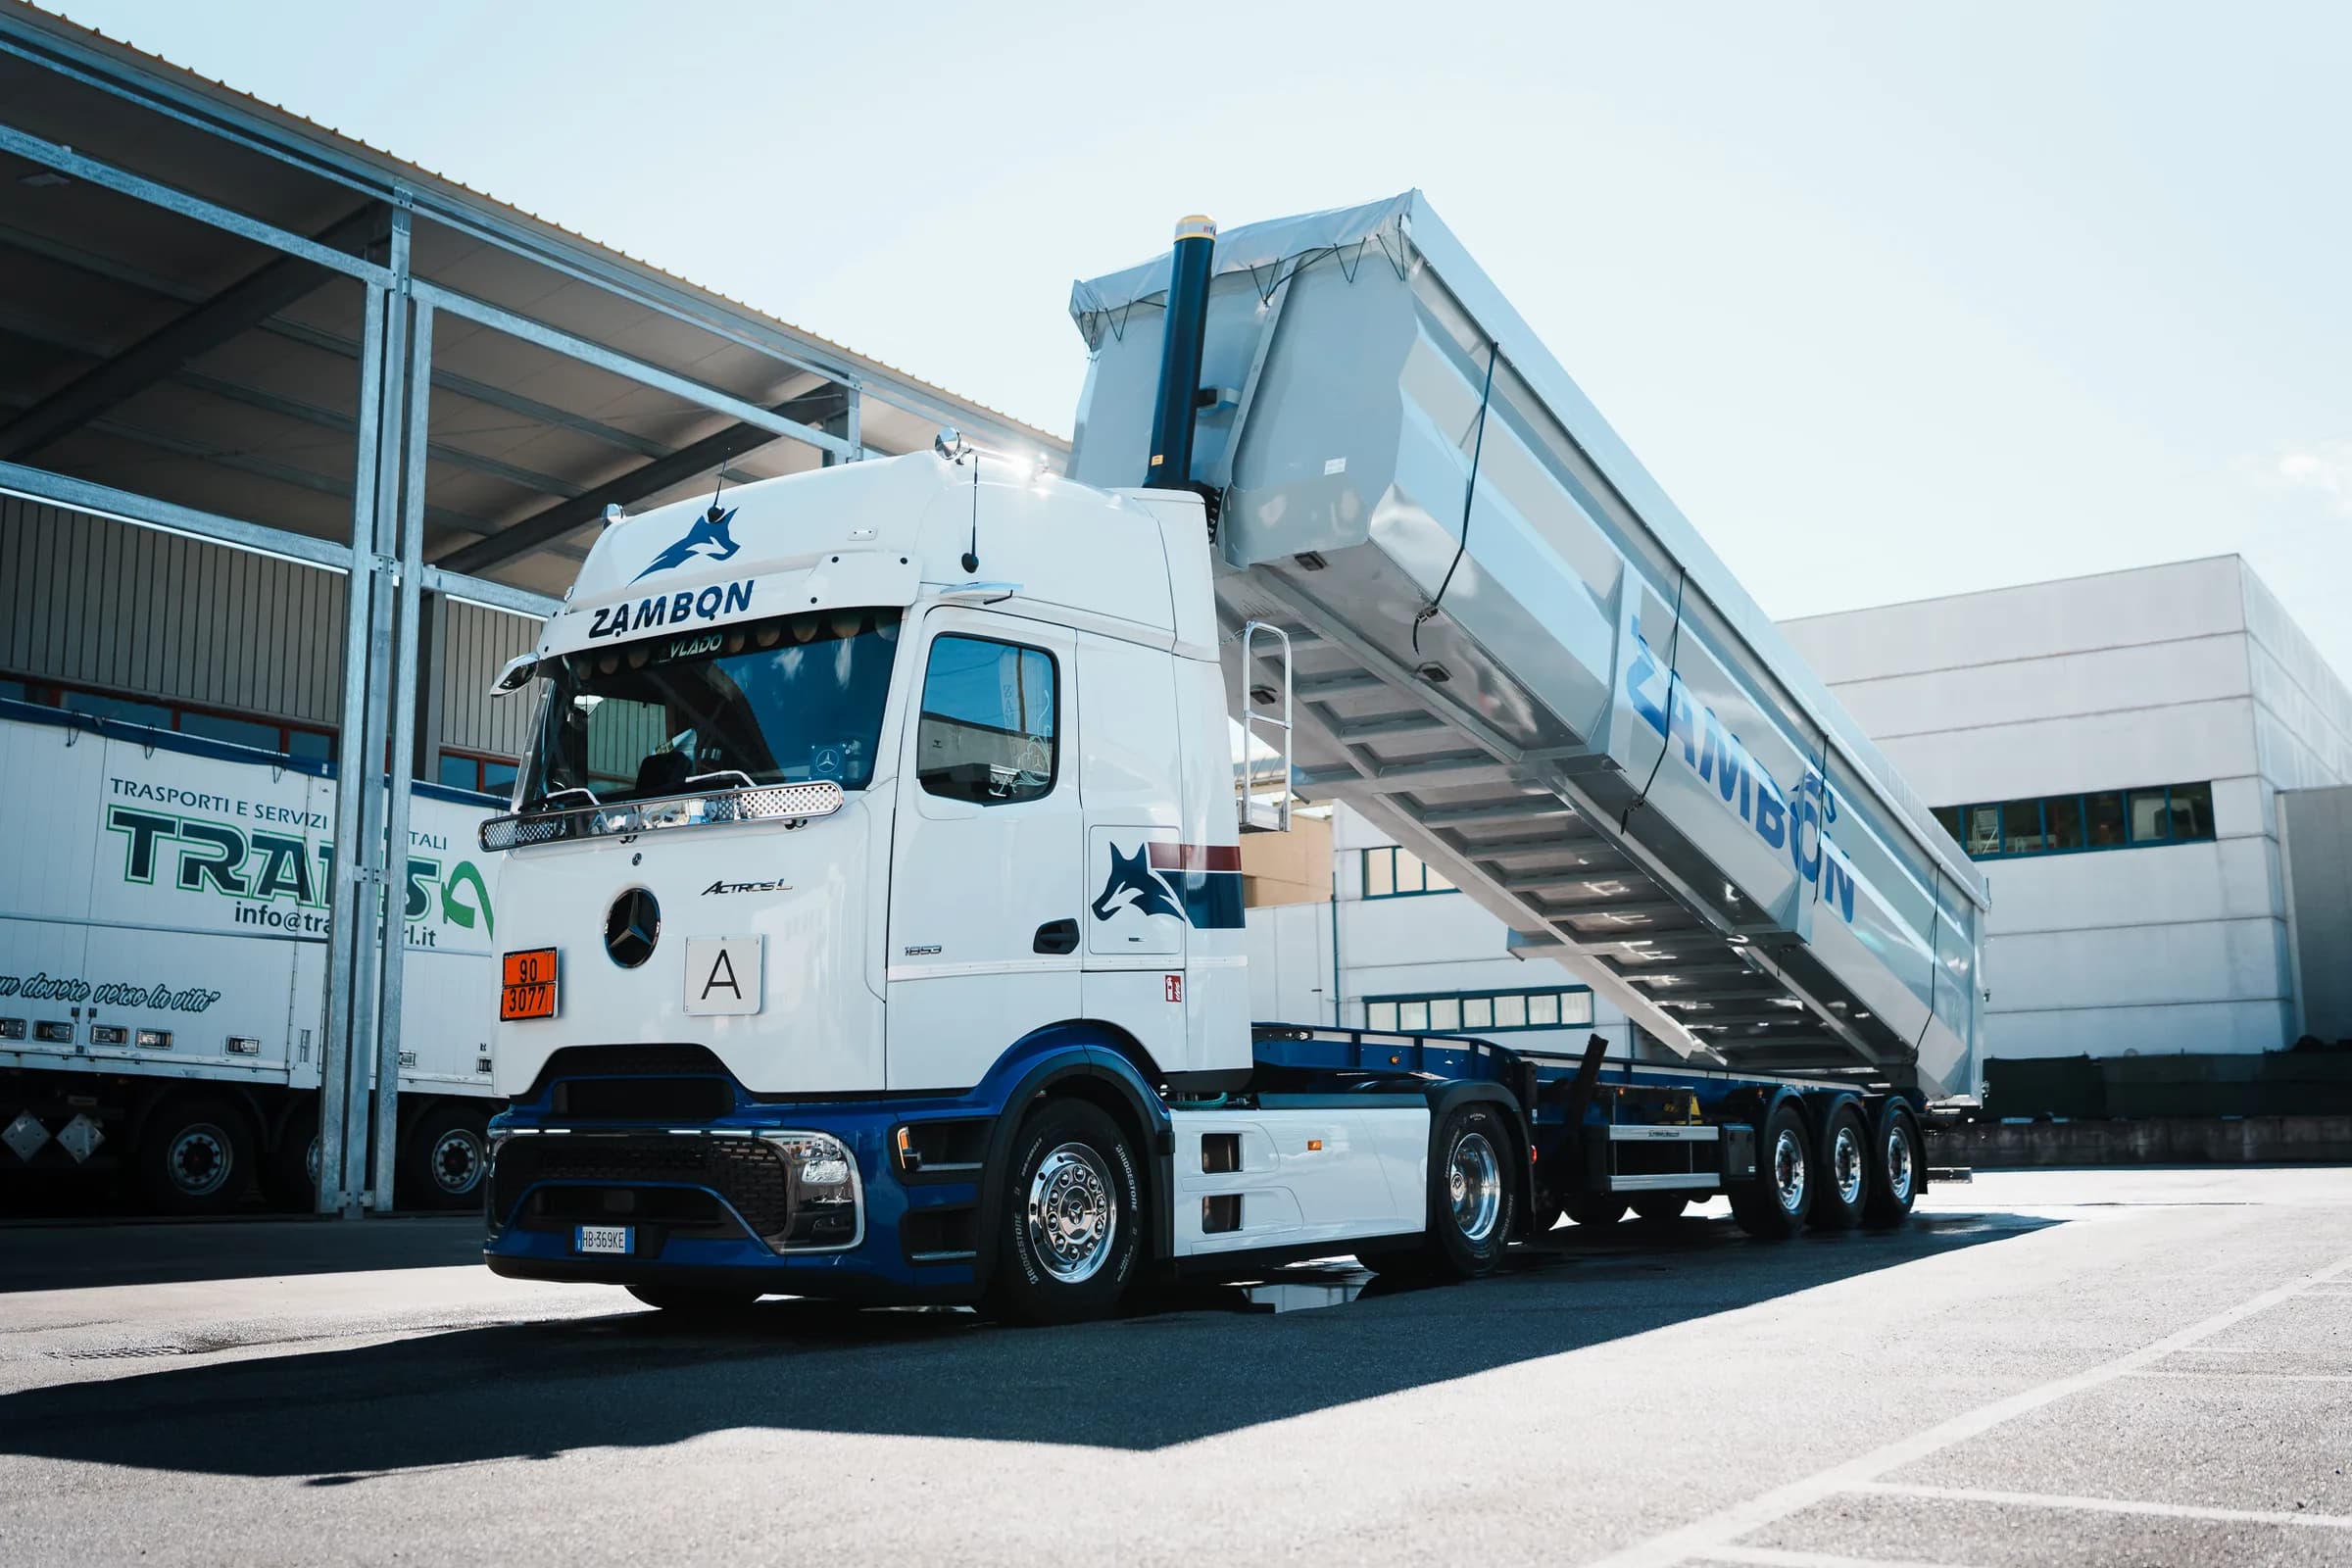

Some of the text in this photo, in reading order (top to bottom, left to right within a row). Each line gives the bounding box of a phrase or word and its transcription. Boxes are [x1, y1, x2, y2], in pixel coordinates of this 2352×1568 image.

[588, 579, 755, 638] ZAMBON
[670, 633, 722, 659] VLADO
[1626, 614, 1854, 923] ZAMBON
[110, 777, 328, 830] TRASPORTI E SERVIZI
[106, 803, 442, 923] TRAS
[21, 972, 91, 1002] dovere
[93, 983, 148, 1006] verso
[147, 983, 172, 1008] la
[519, 957, 537, 983] 90
[701, 949, 742, 1001] A
[509, 985, 546, 1012] 3077
